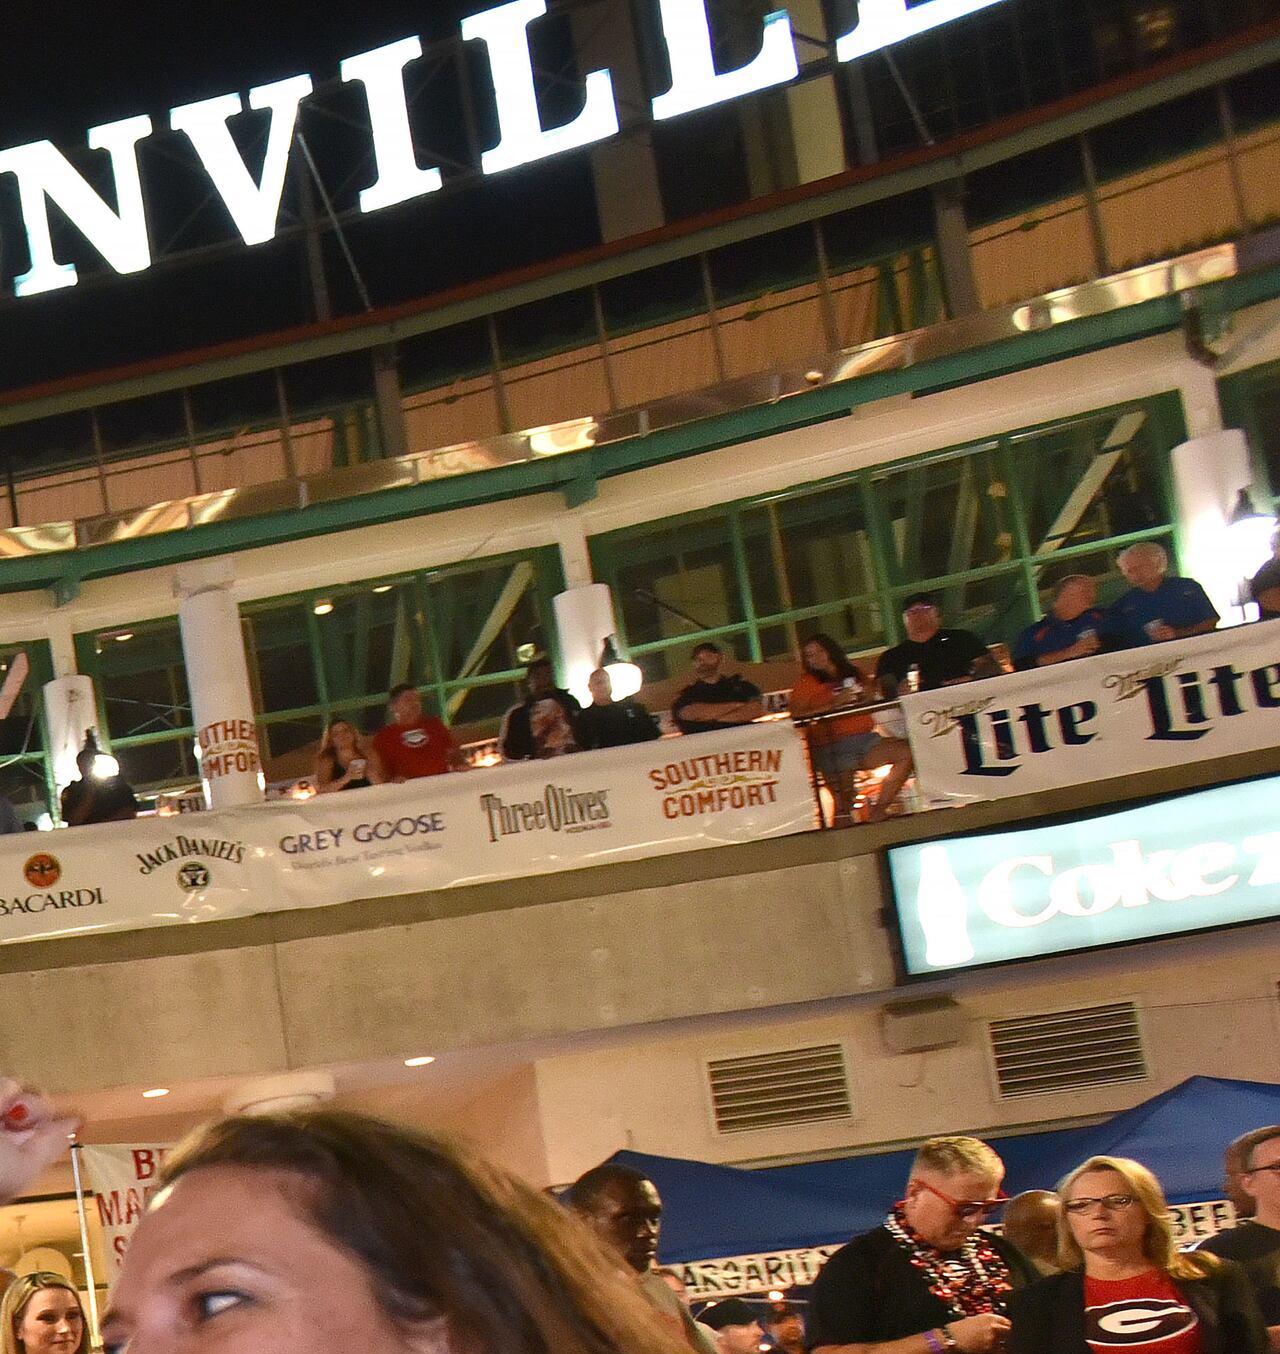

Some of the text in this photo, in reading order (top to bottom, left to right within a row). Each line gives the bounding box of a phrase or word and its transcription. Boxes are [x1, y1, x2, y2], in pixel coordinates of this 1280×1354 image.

[1136, 662, 1280, 741] Lite
[951, 700, 1100, 776] Lite
[648, 749, 783, 791] SOUTHERN
[663, 781, 780, 821] COMFORT
[279, 811, 446, 854] GREY GOOSE
[137, 834, 248, 876] JACK DANIEL'S
[977, 839, 1240, 929] Coke
